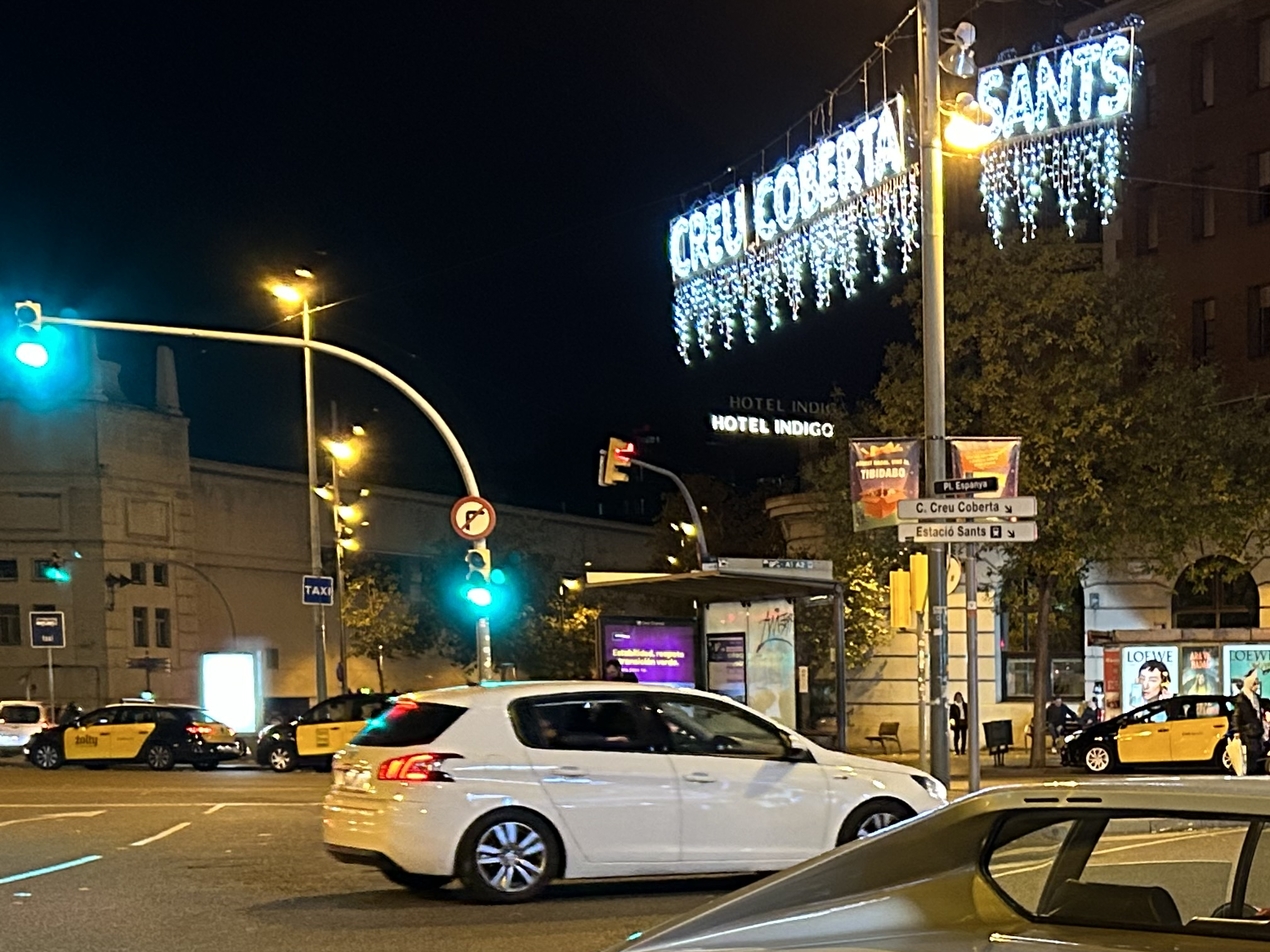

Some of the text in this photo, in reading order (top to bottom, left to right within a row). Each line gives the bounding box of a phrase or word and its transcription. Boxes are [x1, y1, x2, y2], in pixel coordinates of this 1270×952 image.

[670, 35, 1131, 277] CREU COBERTA SANTS
[711, 414, 835, 438] HOTEL INDIGO
[861, 468, 905, 479] TIBIDABO
[955, 481, 988, 491] Espanya
[916, 502, 999, 513] C. Creu Coberta
[916, 525, 987, 538] Estació Sants
[304, 585, 331, 596] TAXI
[1127, 650, 1173, 662] LOEWE
